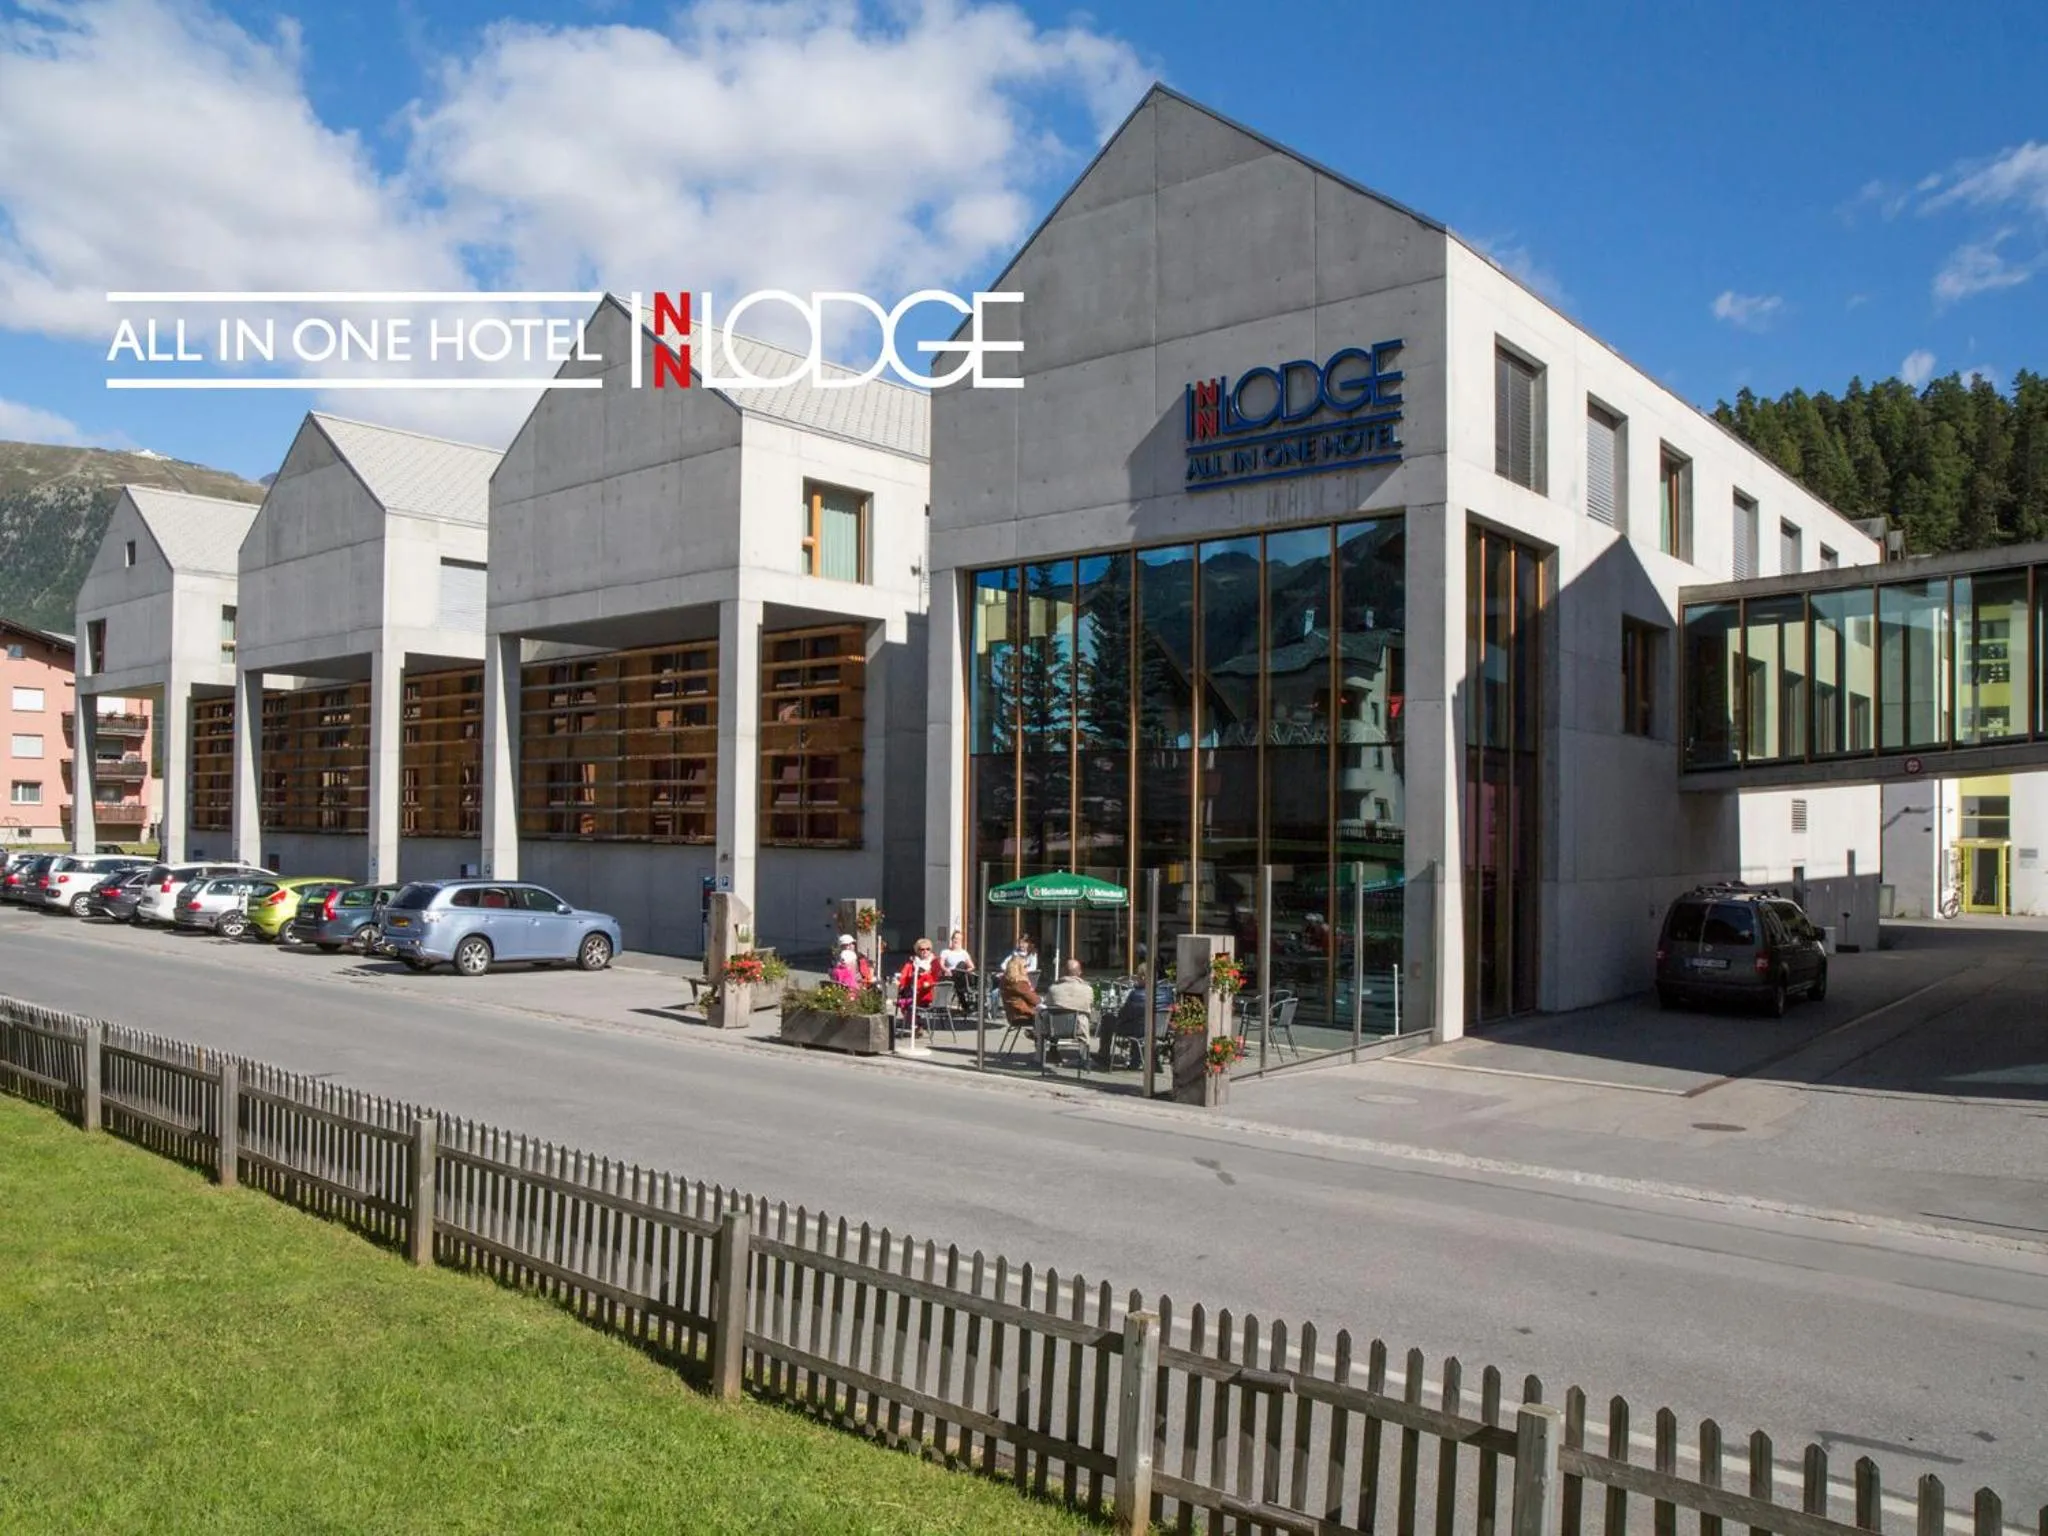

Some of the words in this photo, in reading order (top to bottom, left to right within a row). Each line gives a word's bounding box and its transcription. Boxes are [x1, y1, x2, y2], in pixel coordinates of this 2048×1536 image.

[1186, 454, 1226, 480] ALL
[1234, 448, 1258, 474] IN
[1264, 439, 1317, 468] ONE
[1323, 423, 1403, 459] HOTEL
